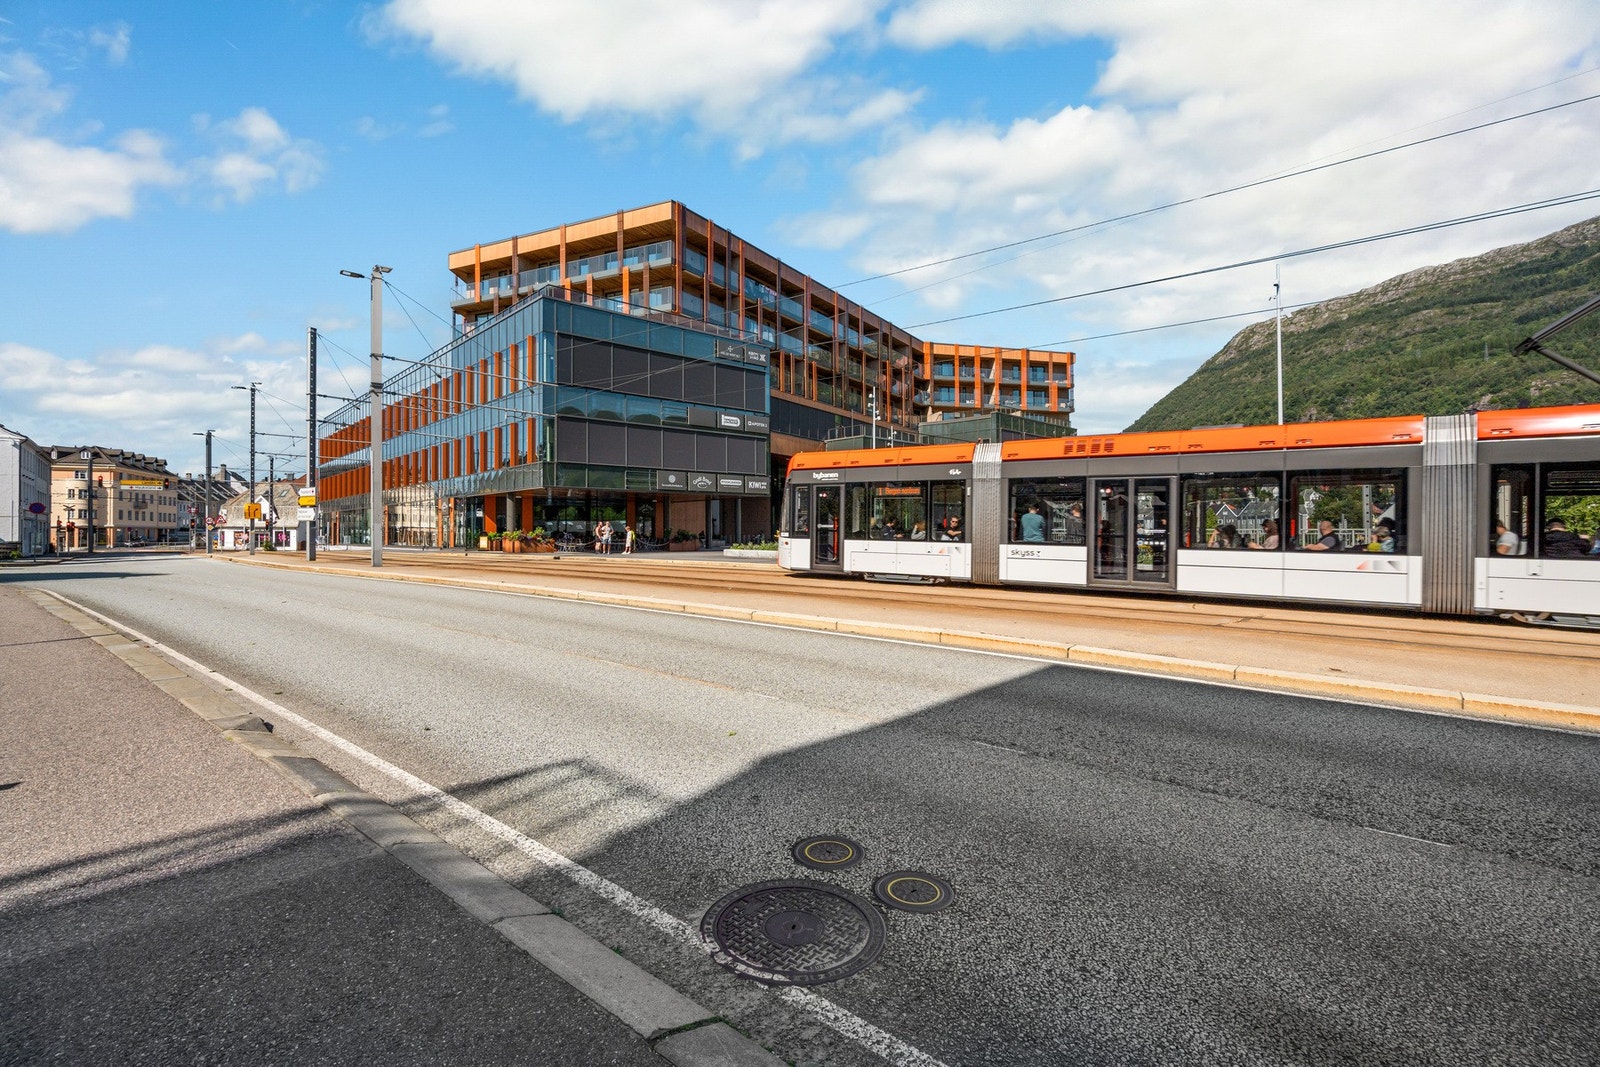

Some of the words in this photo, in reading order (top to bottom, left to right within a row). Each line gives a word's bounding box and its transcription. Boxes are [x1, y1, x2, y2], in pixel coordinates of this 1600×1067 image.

[812, 471, 839, 480] bybanen
[748, 481, 762, 489] KIWI
[1010, 549, 1035, 557] skyss
